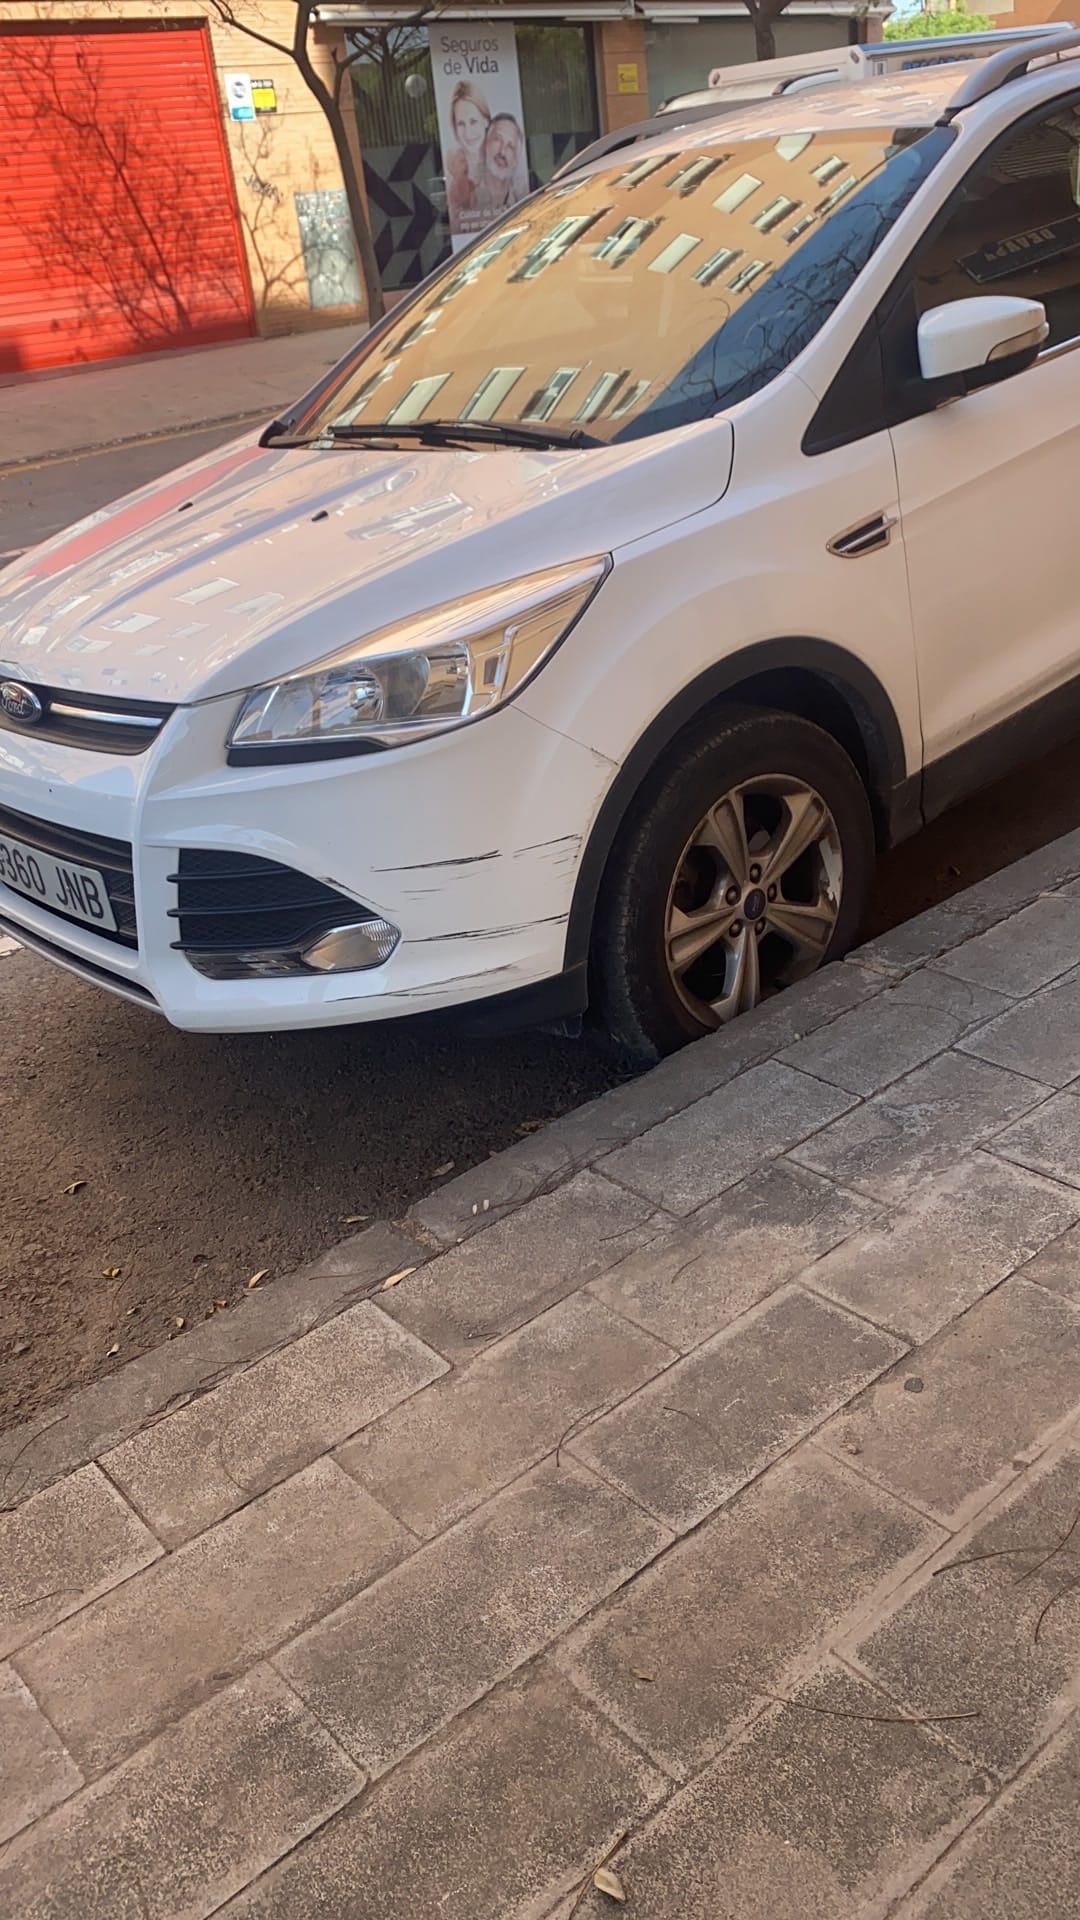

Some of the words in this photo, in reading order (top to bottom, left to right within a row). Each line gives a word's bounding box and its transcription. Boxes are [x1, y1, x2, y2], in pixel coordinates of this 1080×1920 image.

[441, 36, 499, 56] Seguros
[443, 58, 462, 75] de
[464, 56, 499, 74] Vida
[55, 865, 104, 919] JNB
